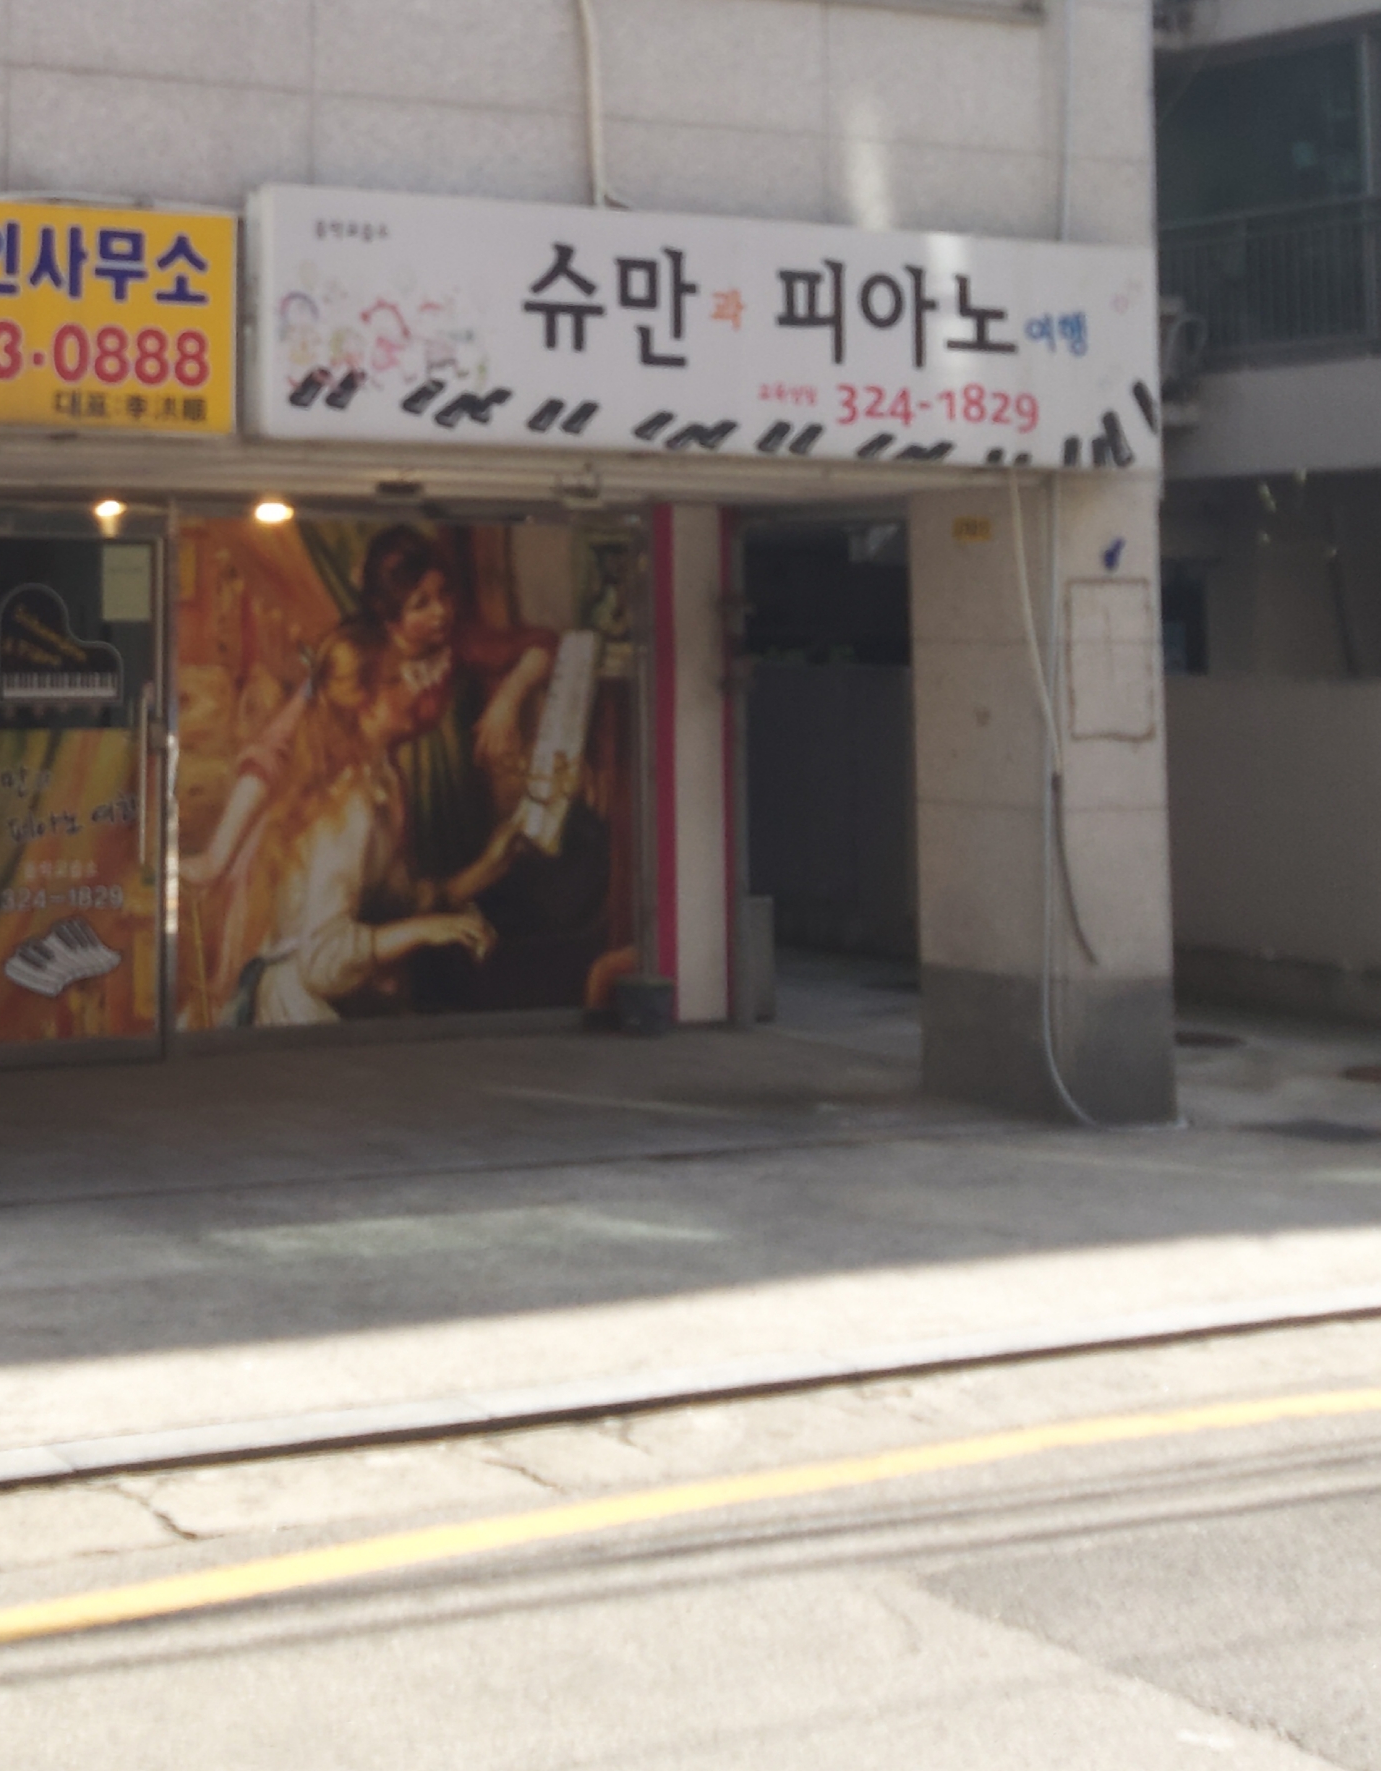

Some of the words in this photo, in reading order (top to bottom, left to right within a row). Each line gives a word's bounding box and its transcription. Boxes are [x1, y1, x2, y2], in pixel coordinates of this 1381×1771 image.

[776, 259, 1018, 368] 피아노
[1024, 311, 1089, 358] 여행
[836, 382, 1040, 434] 324-1829
[1, 885, 124, 910] 324-1829
